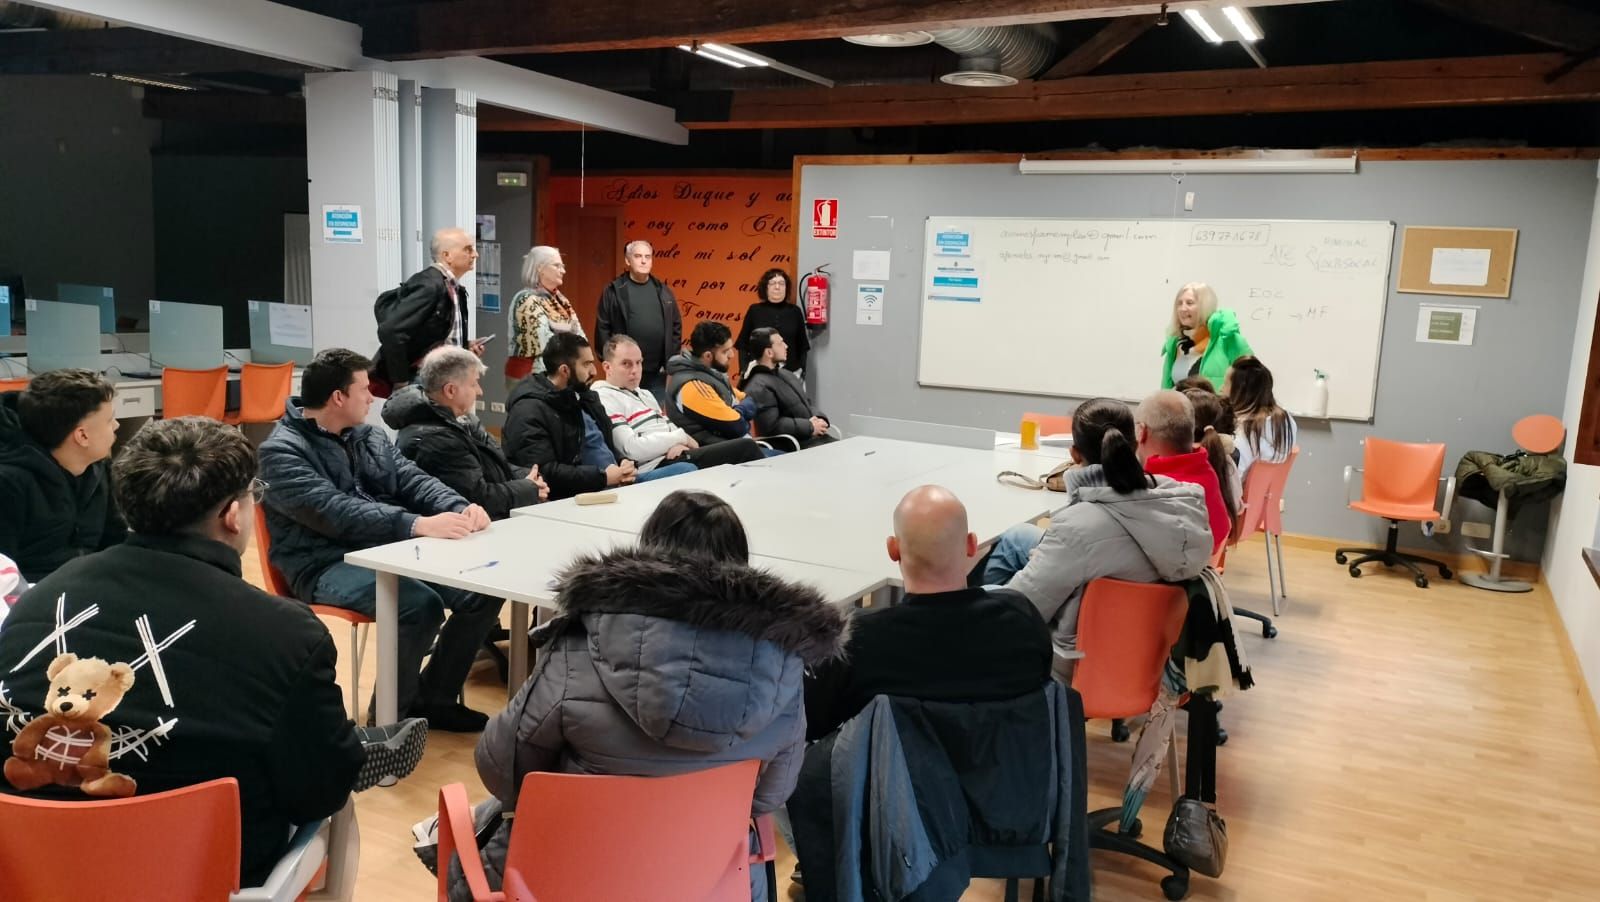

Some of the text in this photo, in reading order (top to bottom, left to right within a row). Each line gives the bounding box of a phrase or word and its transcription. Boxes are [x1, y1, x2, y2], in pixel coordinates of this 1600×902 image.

[673, 181, 736, 208] Duque
[745, 191, 760, 208] y
[688, 221, 729, 231] como
[813, 228, 837, 237] EXTINTOR
[694, 248, 713, 260] mi
[726, 246, 761, 261] sol
[696, 280, 725, 296] por
[678, 299, 742, 322] Tormes
